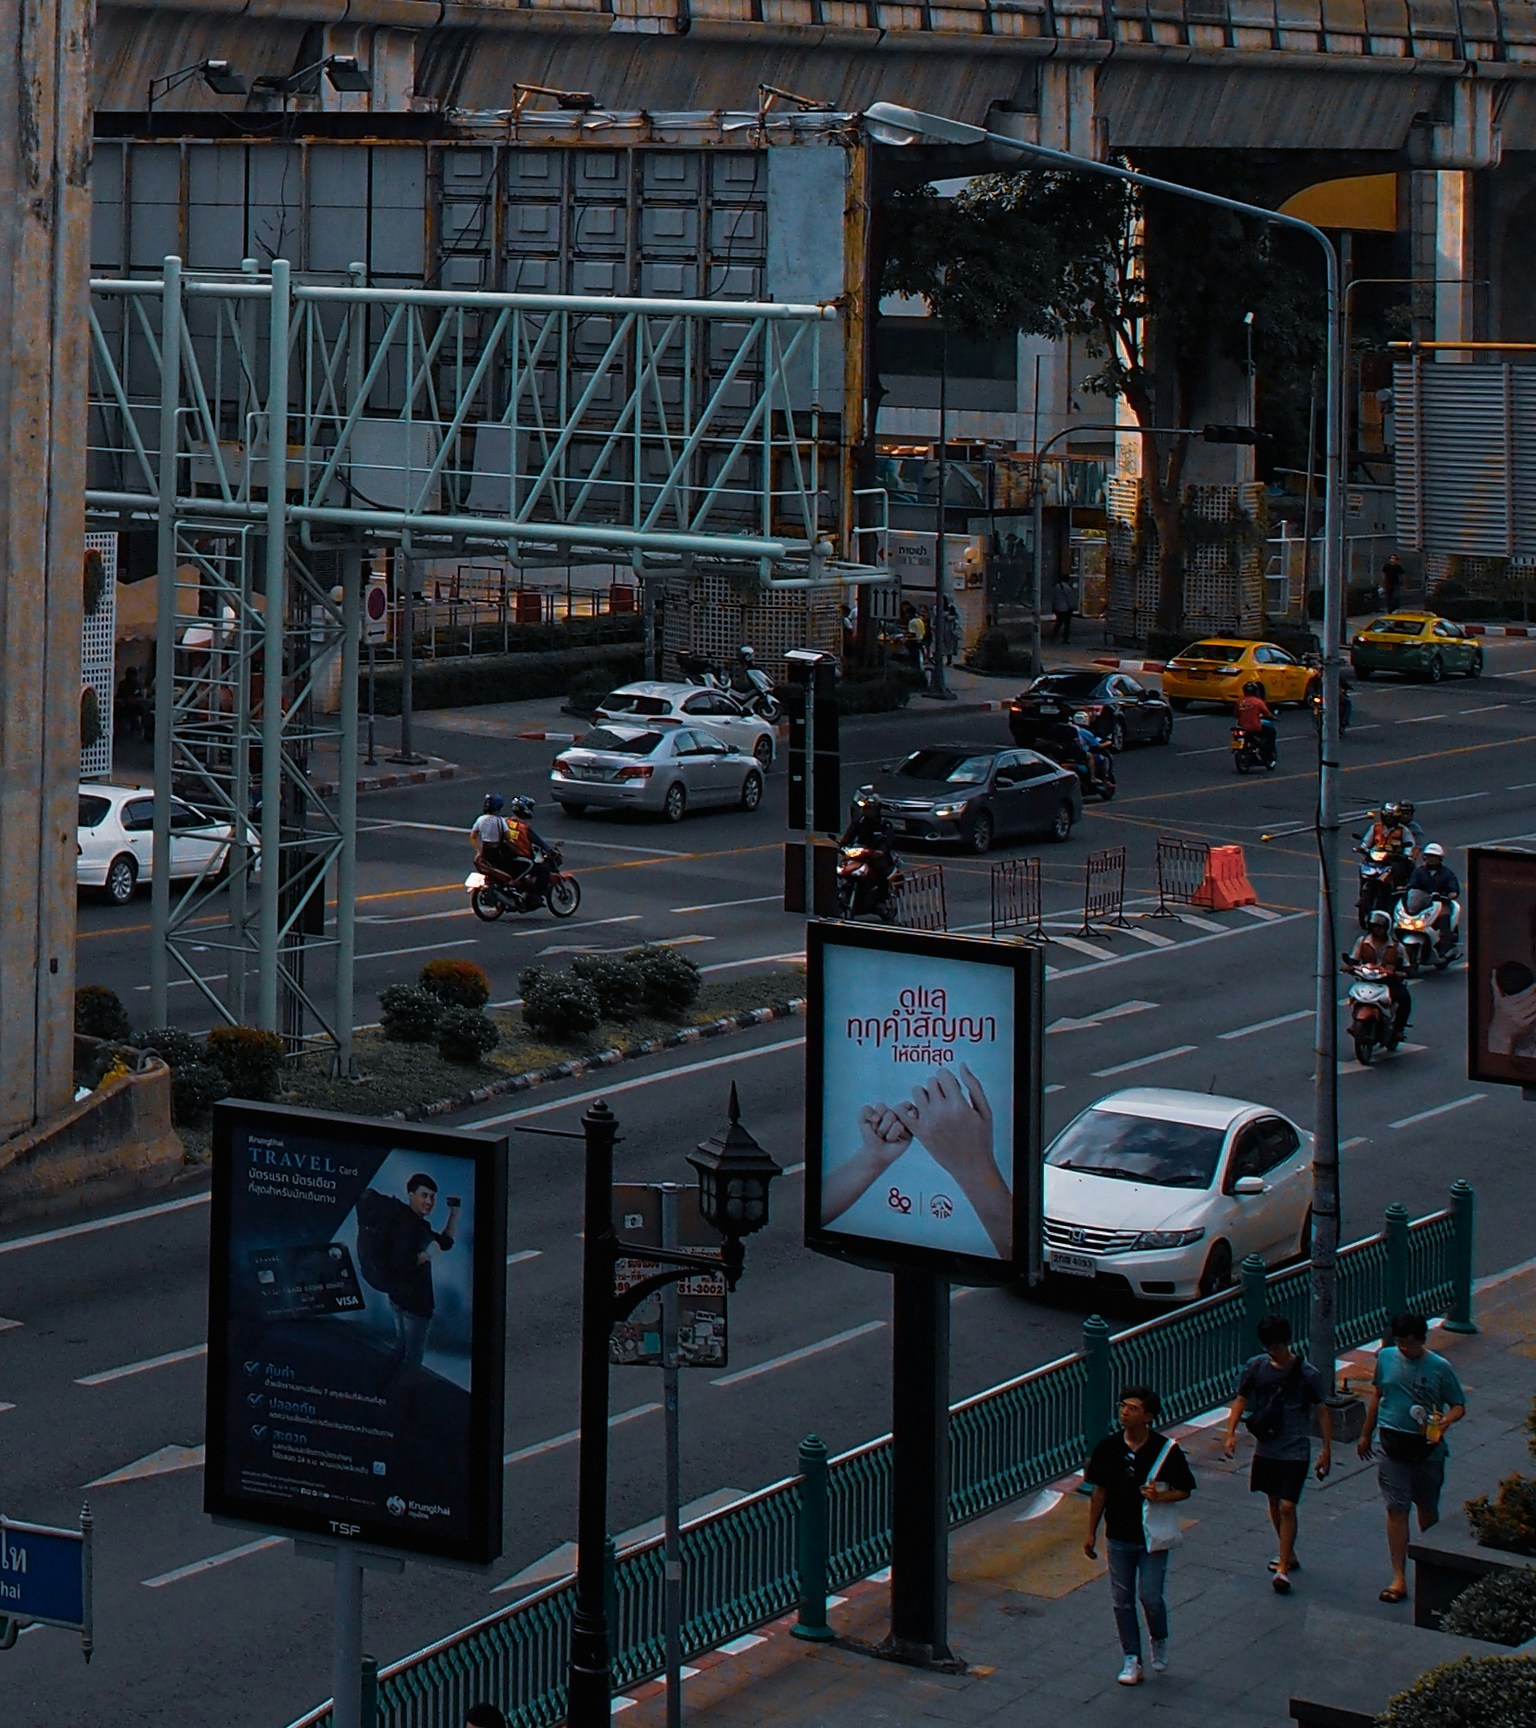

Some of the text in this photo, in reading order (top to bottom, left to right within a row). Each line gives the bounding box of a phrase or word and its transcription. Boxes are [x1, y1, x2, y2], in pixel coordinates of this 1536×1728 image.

[900, 985, 946, 1016] ดูแล
[847, 1009, 996, 1048] ทุกคำสัญญา
[892, 1040, 954, 1066] ให้ดีที่สุด
[248, 1147, 359, 1177] TRAVEL Card
[335, 1295, 359, 1307] VISA
[408, 1499, 451, 1517] Krungthai
[329, 1520, 362, 1537] TSF
